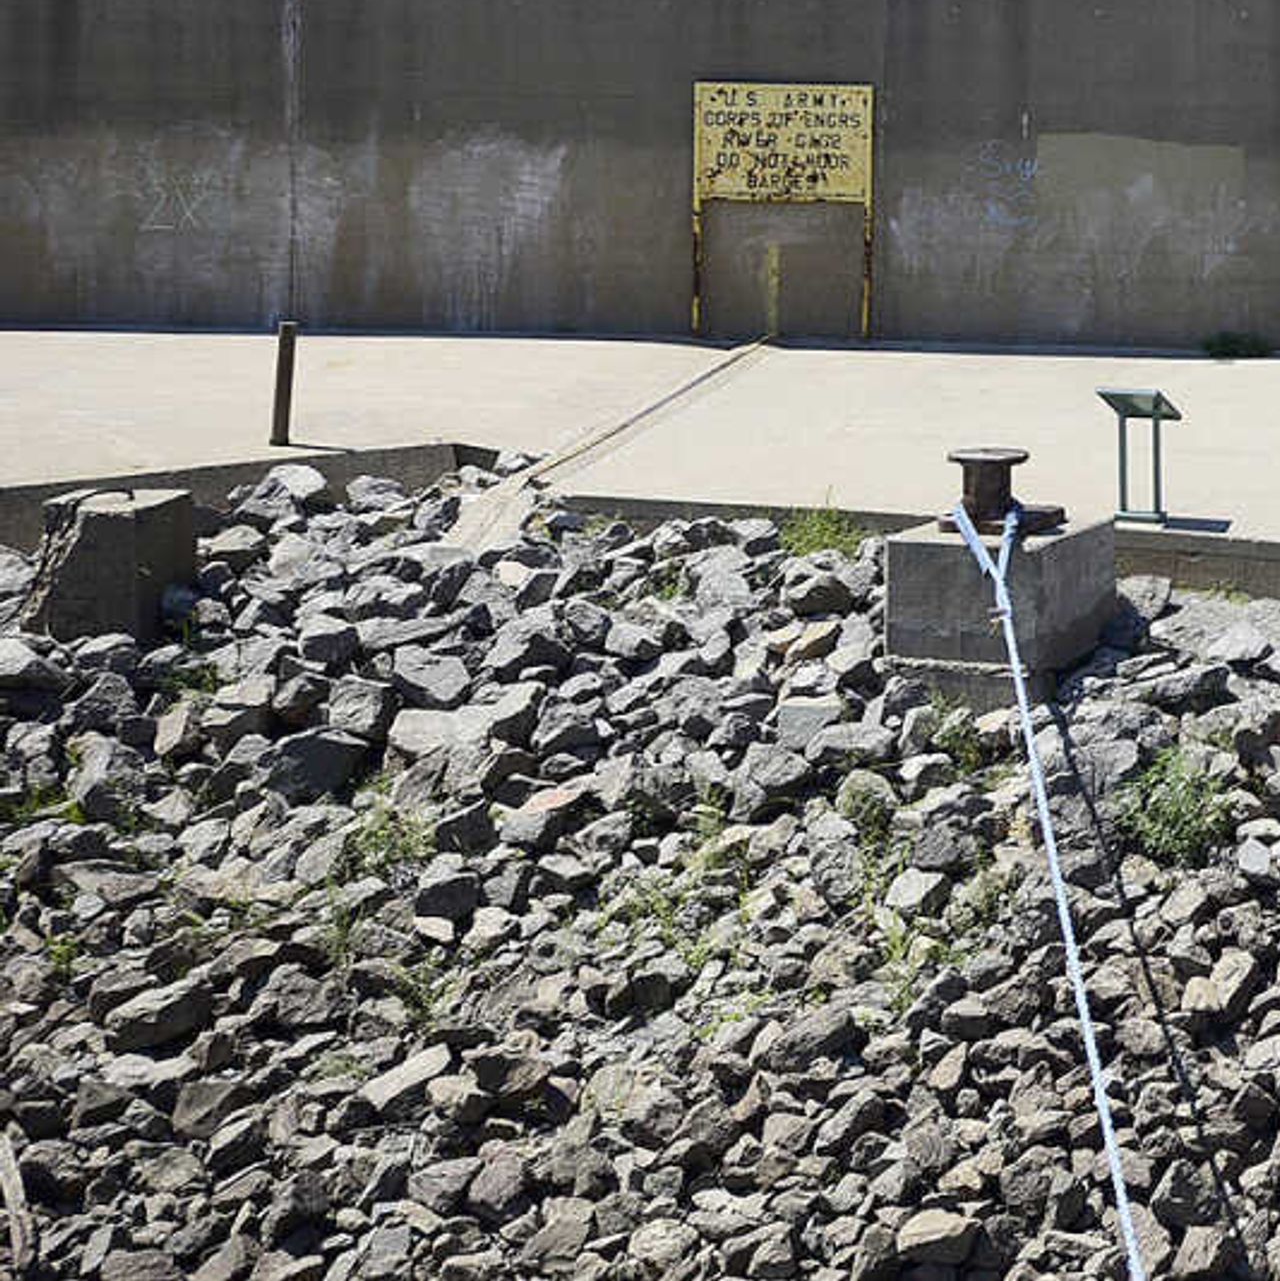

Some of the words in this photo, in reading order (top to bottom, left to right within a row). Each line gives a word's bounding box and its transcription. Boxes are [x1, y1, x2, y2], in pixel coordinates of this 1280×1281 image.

[783, 93, 838, 108] ARMY
[703, 110, 762, 127] CORPS
[717, 152, 741, 168] DO
[754, 152, 789, 169] NOT
